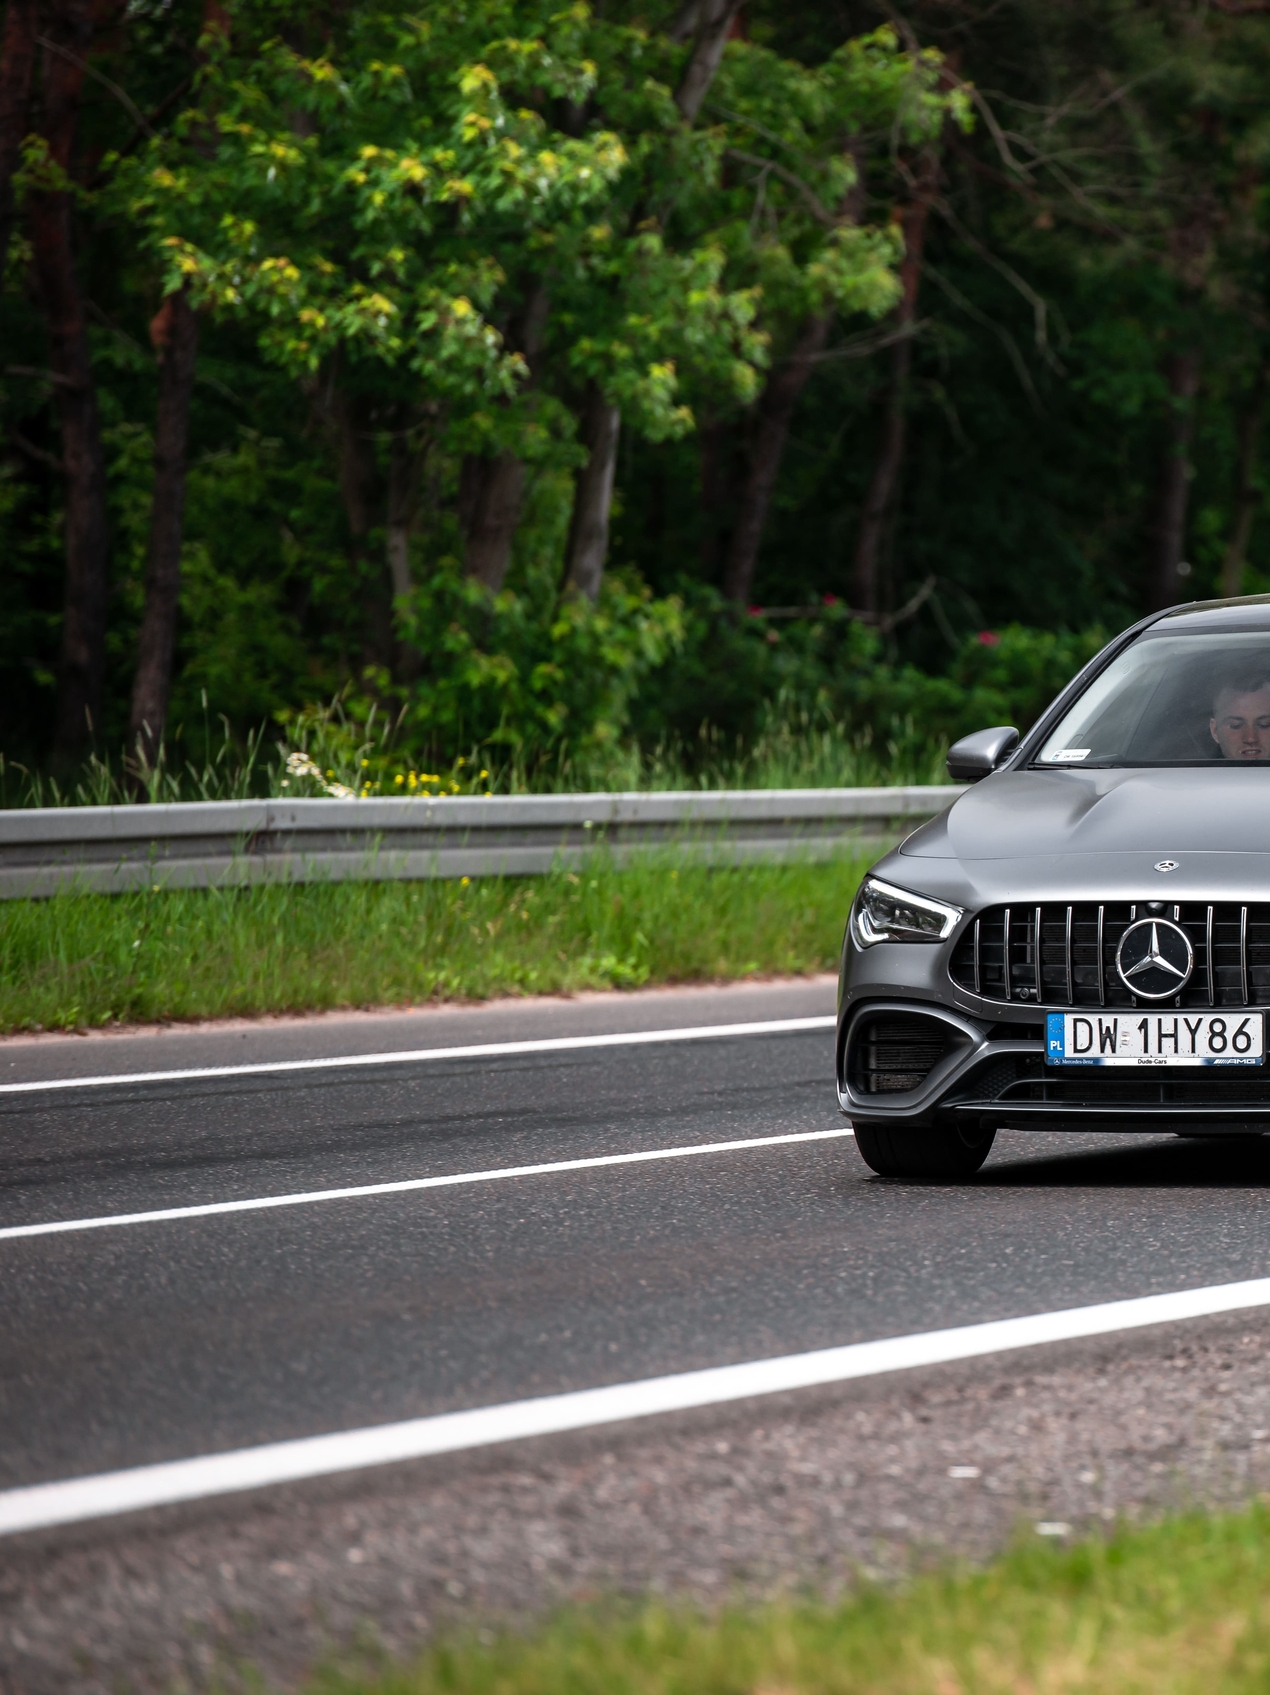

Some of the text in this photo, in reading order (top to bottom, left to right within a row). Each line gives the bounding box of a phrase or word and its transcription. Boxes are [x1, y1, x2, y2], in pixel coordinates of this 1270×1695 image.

[1050, 1040, 1063, 1051] PL
[1072, 1017, 1252, 1054] DW 1HY86
